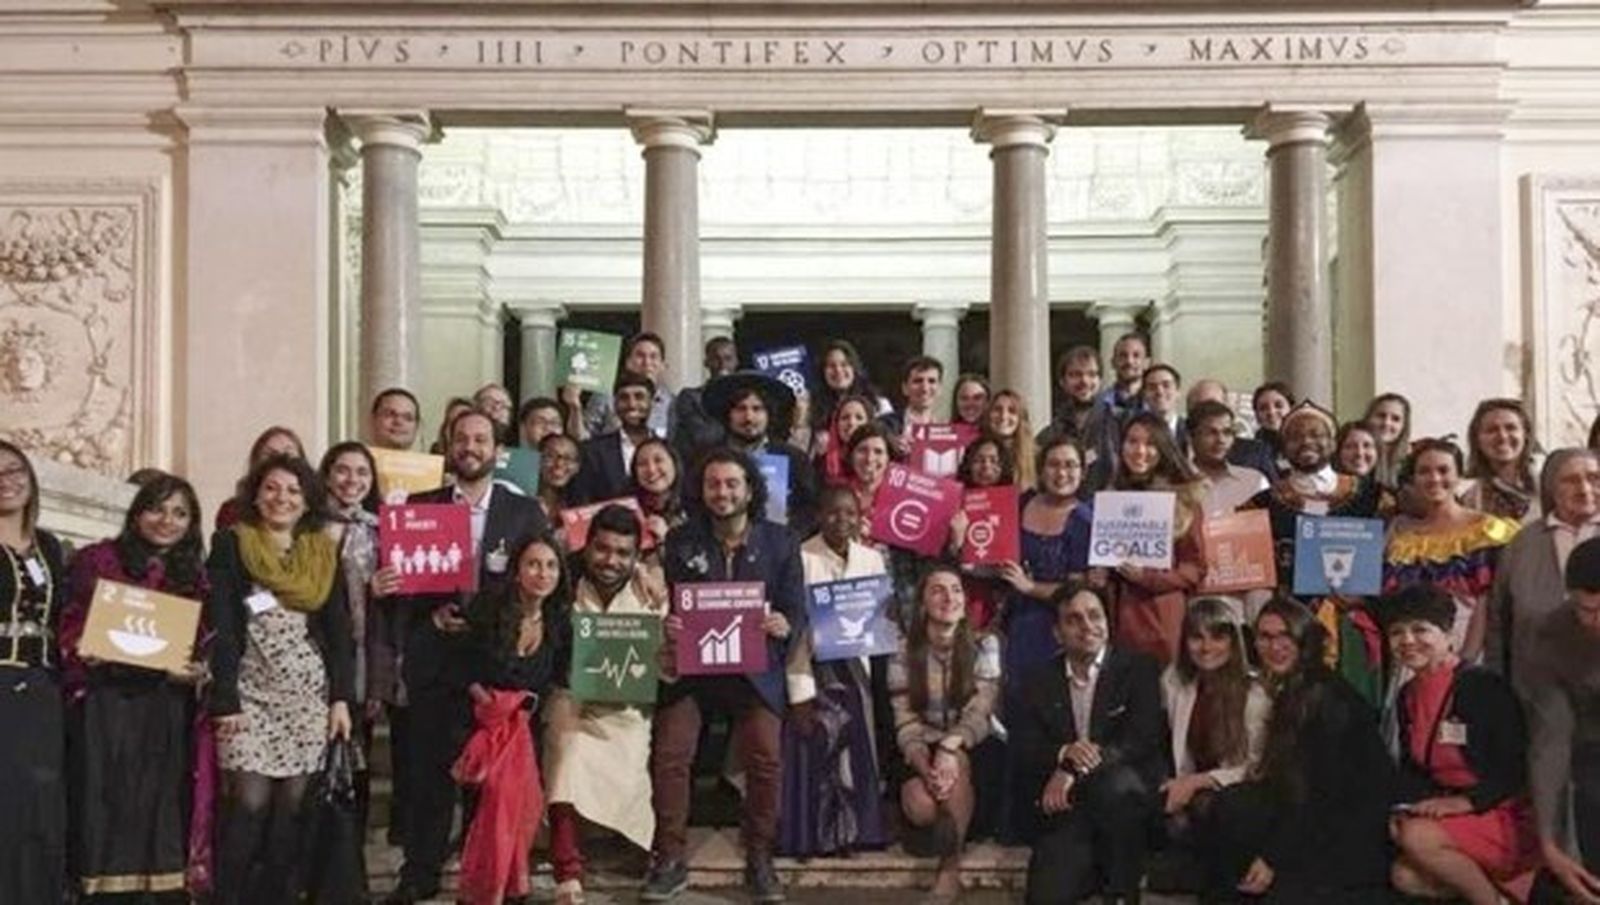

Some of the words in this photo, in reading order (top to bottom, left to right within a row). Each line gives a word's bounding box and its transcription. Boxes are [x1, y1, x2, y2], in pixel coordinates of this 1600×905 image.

[476, 41, 545, 64] IIII
[620, 41, 847, 65] PONTIFEX
[920, 40, 1114, 64] OPTIMVS
[1186, 36, 1370, 62] MAXIMVS
[388, 509, 398, 531] 1
[1093, 539, 1168, 559] GOALS
[101, 583, 118, 603] 2
[681, 588, 693, 611] 8
[813, 586, 831, 605] 16
[579, 616, 592, 638] 3
